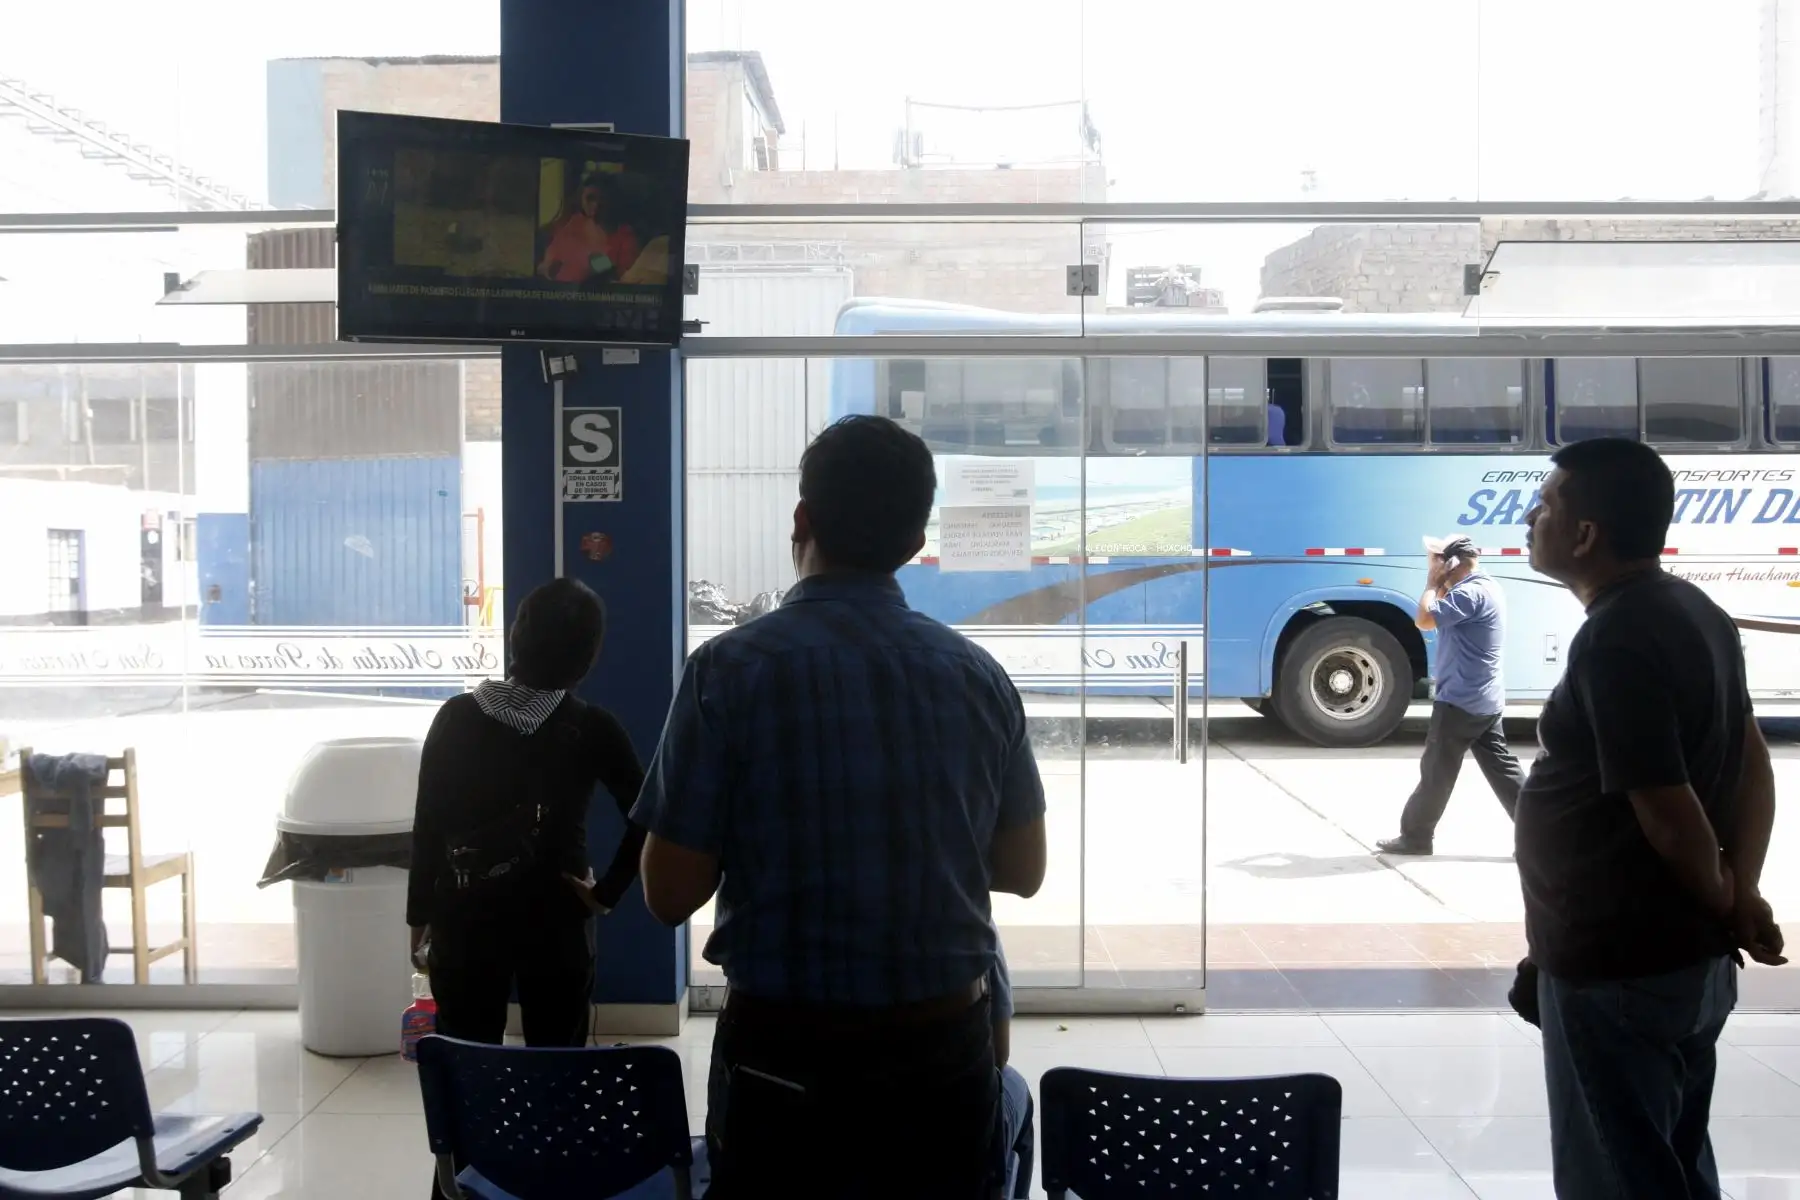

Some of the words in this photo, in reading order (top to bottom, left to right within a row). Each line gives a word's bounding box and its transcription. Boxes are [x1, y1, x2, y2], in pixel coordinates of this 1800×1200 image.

[568, 413, 613, 463] S
[1481, 470, 1551, 483] EMPR
[1670, 469, 1796, 482] NSPORTES
[1670, 488, 1752, 524] TIN
